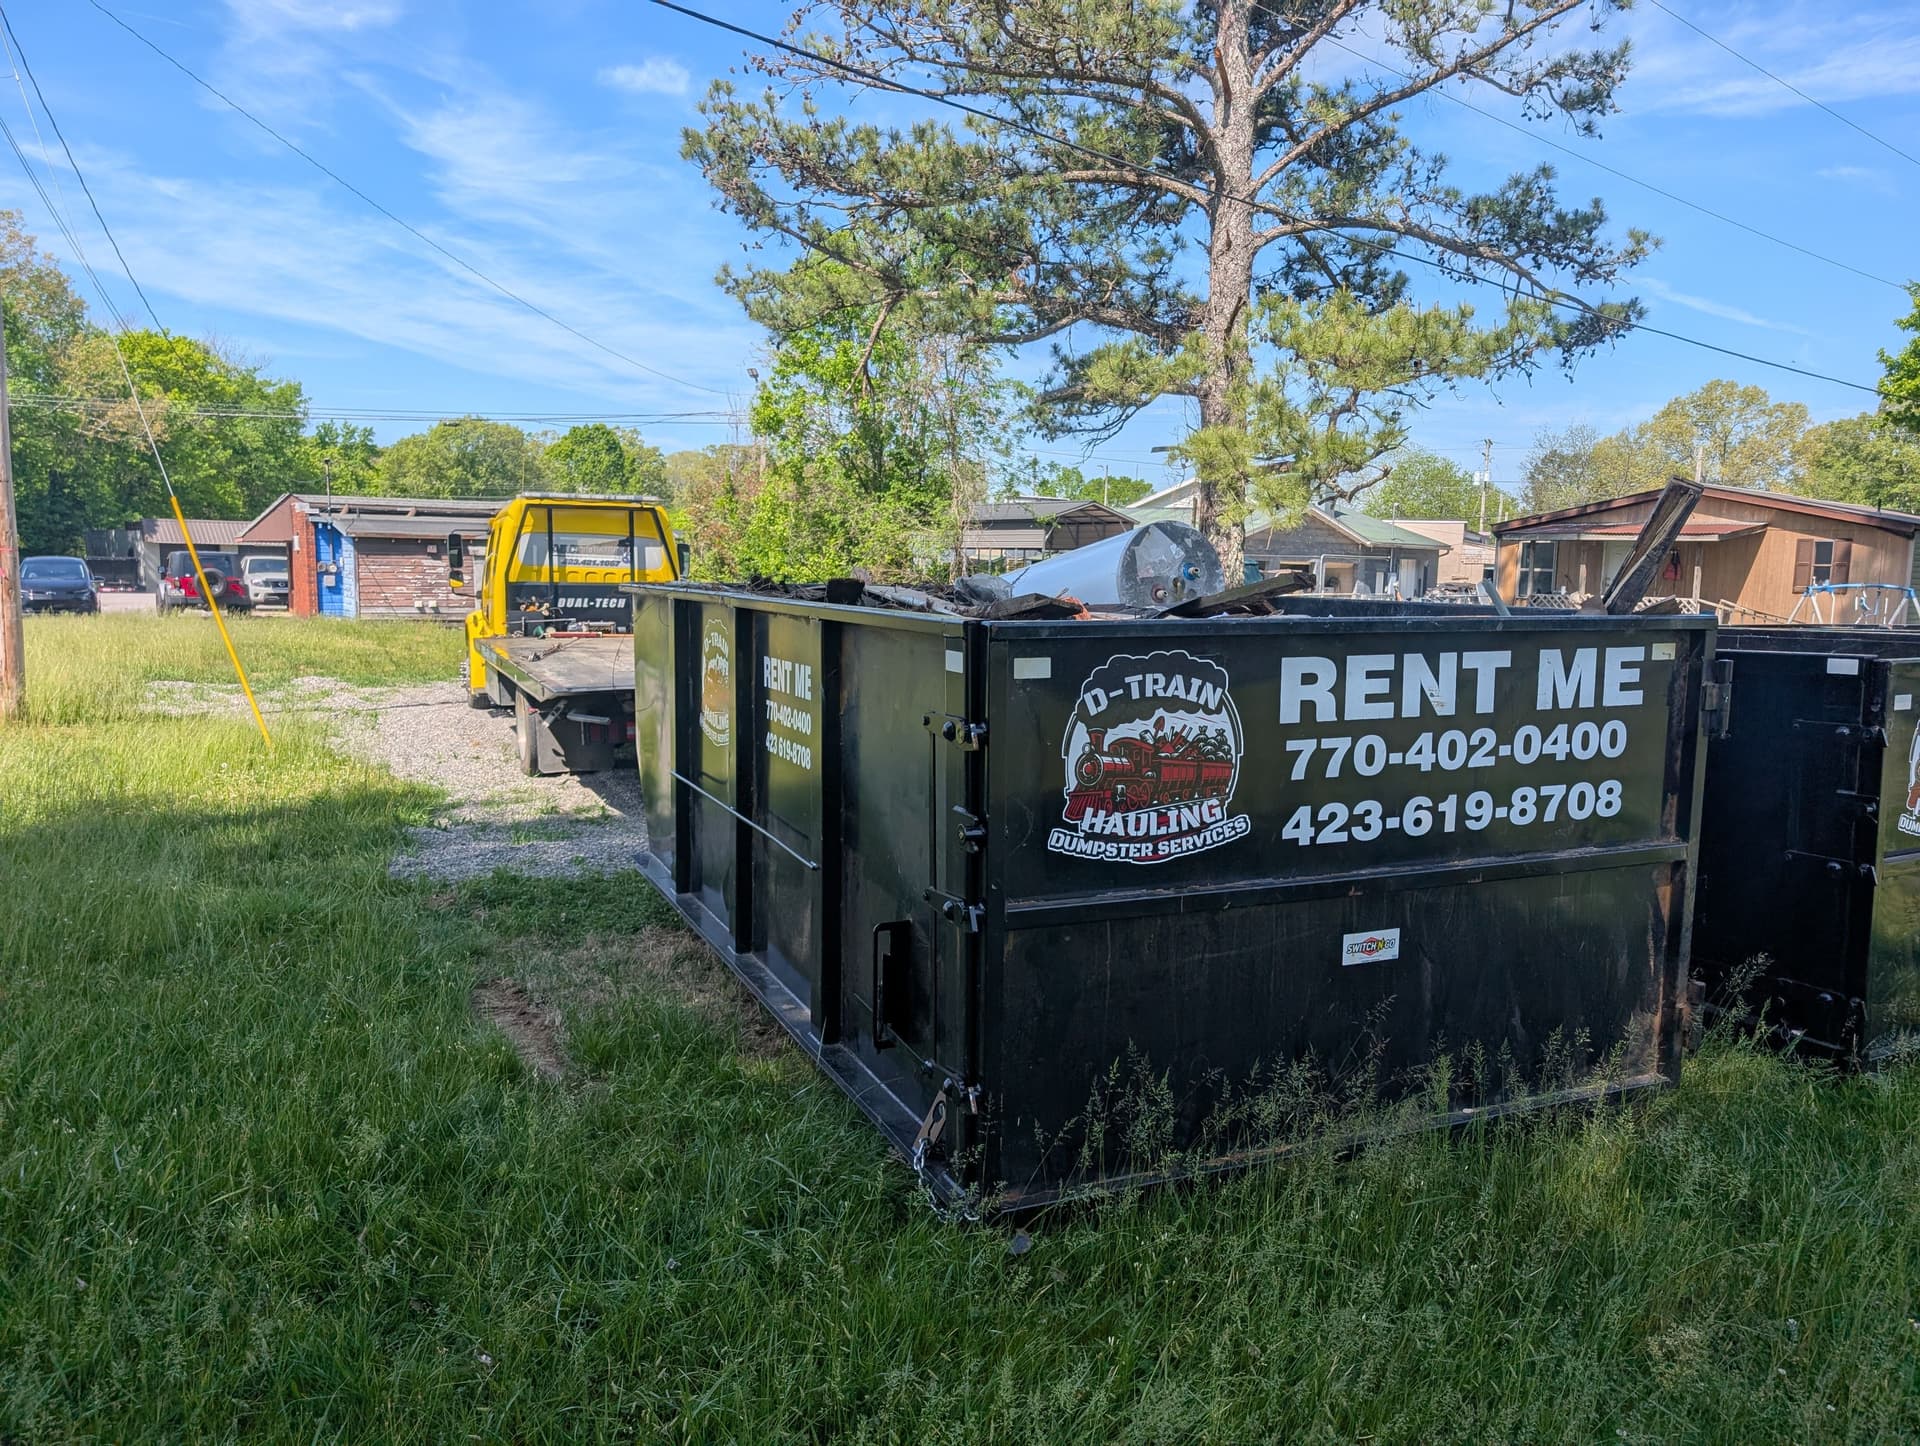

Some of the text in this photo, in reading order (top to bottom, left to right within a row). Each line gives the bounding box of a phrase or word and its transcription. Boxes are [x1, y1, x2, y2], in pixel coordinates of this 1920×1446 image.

[557, 597, 626, 608] DUAL-TECH
[763, 655, 812, 701] RENT ME
[1083, 673, 1223, 717] D-TRAIN
[1280, 646, 1645, 724] RENT ME
[766, 699, 811, 736] 770-402-0400
[1286, 719, 1628, 780] 770-402-0400
[1081, 798, 1224, 838] HAULING
[1282, 779, 1623, 846] 423-619-8708
[1051, 816, 1248, 859] DUMPSTER SERVICES
[1346, 940, 1377, 954] SWITCH
